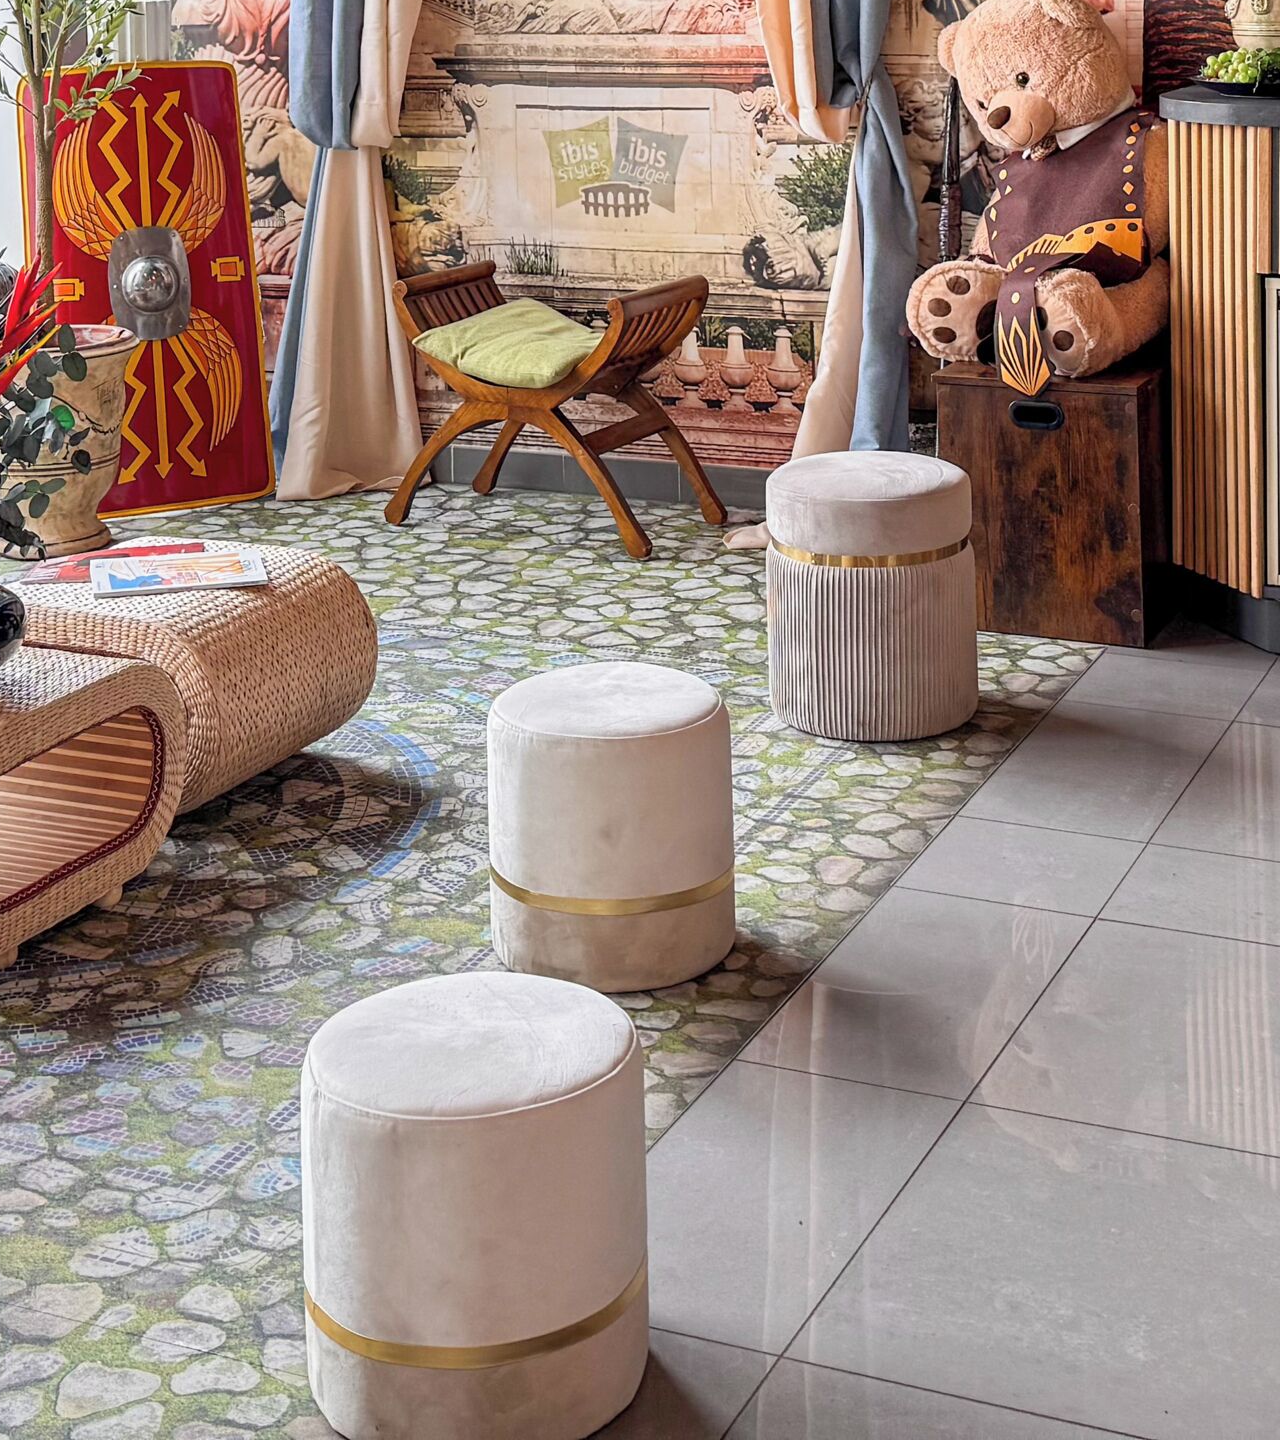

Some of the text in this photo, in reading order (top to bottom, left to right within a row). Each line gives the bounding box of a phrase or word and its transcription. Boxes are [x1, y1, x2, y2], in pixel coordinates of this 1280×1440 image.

[560, 138, 599, 166] ibis
[628, 137, 667, 168] ibis
[619, 158, 671, 185] budget
